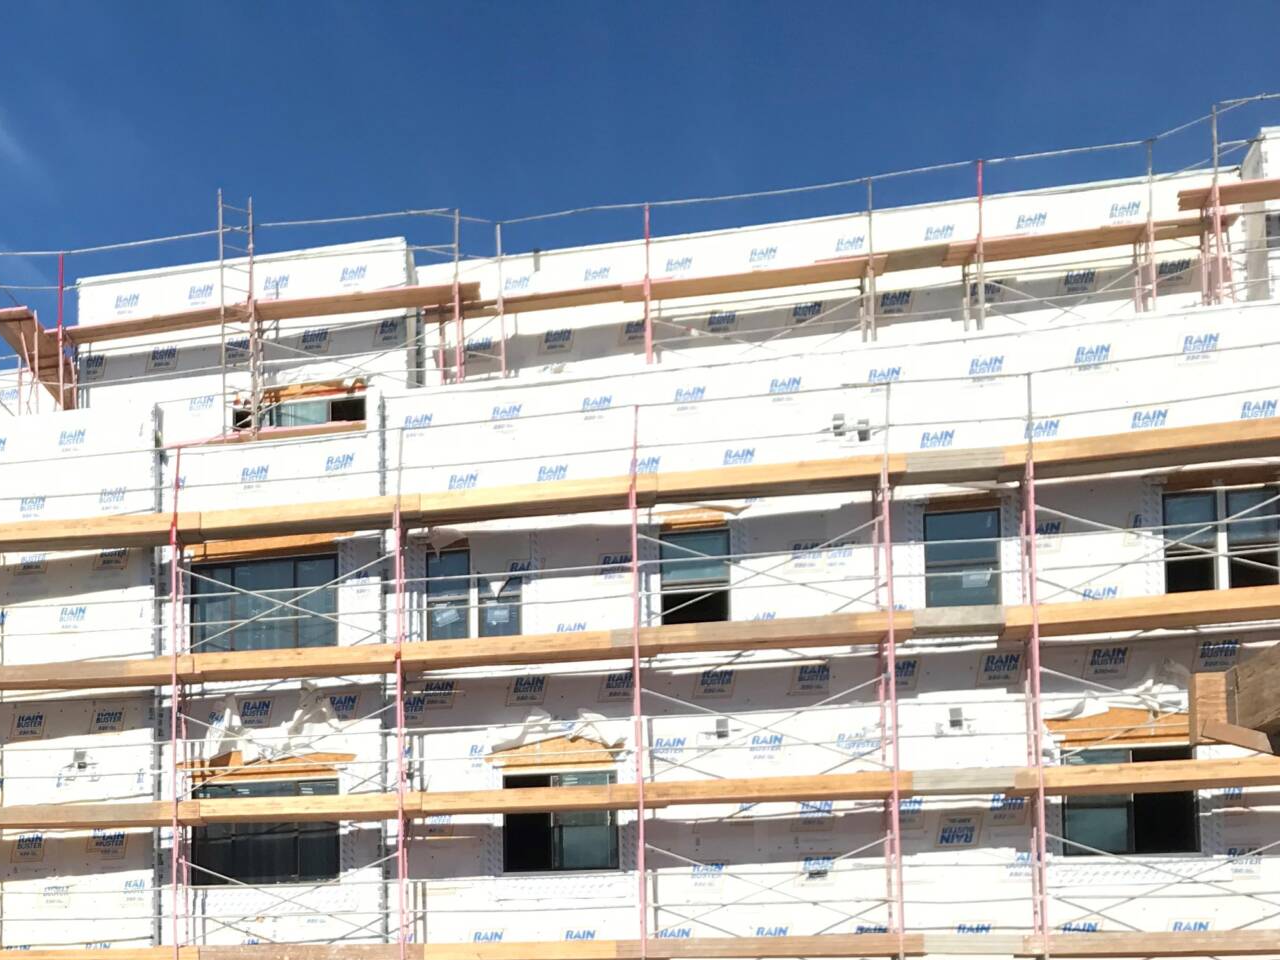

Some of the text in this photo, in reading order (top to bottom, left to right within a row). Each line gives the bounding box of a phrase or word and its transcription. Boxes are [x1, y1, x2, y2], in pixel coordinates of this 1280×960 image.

[1111, 201, 1141, 211] RAIN
[1017, 212, 1047, 223] RAIN
[925, 224, 955, 234] RAIN
[836, 236, 865, 246] RAIN
[750, 247, 778, 256] RAIN
[667, 257, 693, 267] RAIN
[341, 265, 367, 276] RAIN
[264, 275, 289, 284] RAIN
[190, 283, 214, 293] RAIN
[116, 293, 139, 303] RAIN
[882, 290, 911, 301] RAIN
[1184, 333, 1219, 345] RAIN
[1075, 344, 1111, 356] RAIN
[970, 356, 1004, 367] RAIN
[869, 367, 901, 378] RAIN
[771, 377, 801, 388] RAIN
[676, 386, 705, 396] RAIN
[583, 395, 612, 406] RAIN
[1242, 400, 1278, 412] RAIN
[493, 404, 522, 415] RAIN
[1132, 409, 1168, 421] RAIN
[405, 414, 433, 424] RAIN
[1025, 420, 1060, 431] RAIN
[60, 428, 85, 440] RAIN
[922, 430, 954, 441] RAIN
[724, 447, 755, 459] RAIN
[326, 453, 355, 465] RAIN
[630, 456, 661, 467] RAIN
[242, 465, 269, 476] RAIN
[538, 464, 568, 475] RAIN
[450, 472, 478, 483] RAIN
[21, 496, 46, 506] RAIN
[1082, 586, 1117, 600] RAIN
[60, 606, 87, 616] RAIN
[557, 622, 586, 632] RAIN
[1092, 647, 1128, 658] RAIN
[986, 654, 1020, 664] RAIN
[702, 670, 734, 679] RAIN
[799, 665, 830, 675] RAIN
[425, 680, 455, 691] RAIN
[515, 677, 545, 687] RAIN
[242, 700, 271, 711] RAIN
[330, 695, 357, 706] RAIN
[404, 697, 425, 706] AIN
[332, 704, 355, 712] USTER
[655, 737, 686, 748] RAIN
[752, 734, 783, 746] RAIN
[18, 834, 44, 843] RAIN
[940, 832, 973, 843] RAIN
[1233, 855, 1263, 865] USTER
[124, 880, 145, 889] RAI
[757, 926, 788, 936] RAIN
[1063, 922, 1098, 932] RAIN
[1173, 921, 1210, 932] RAIN
[474, 932, 503, 940] RAIN
[566, 930, 595, 939] RAIN
[660, 928, 691, 938] RAIN
